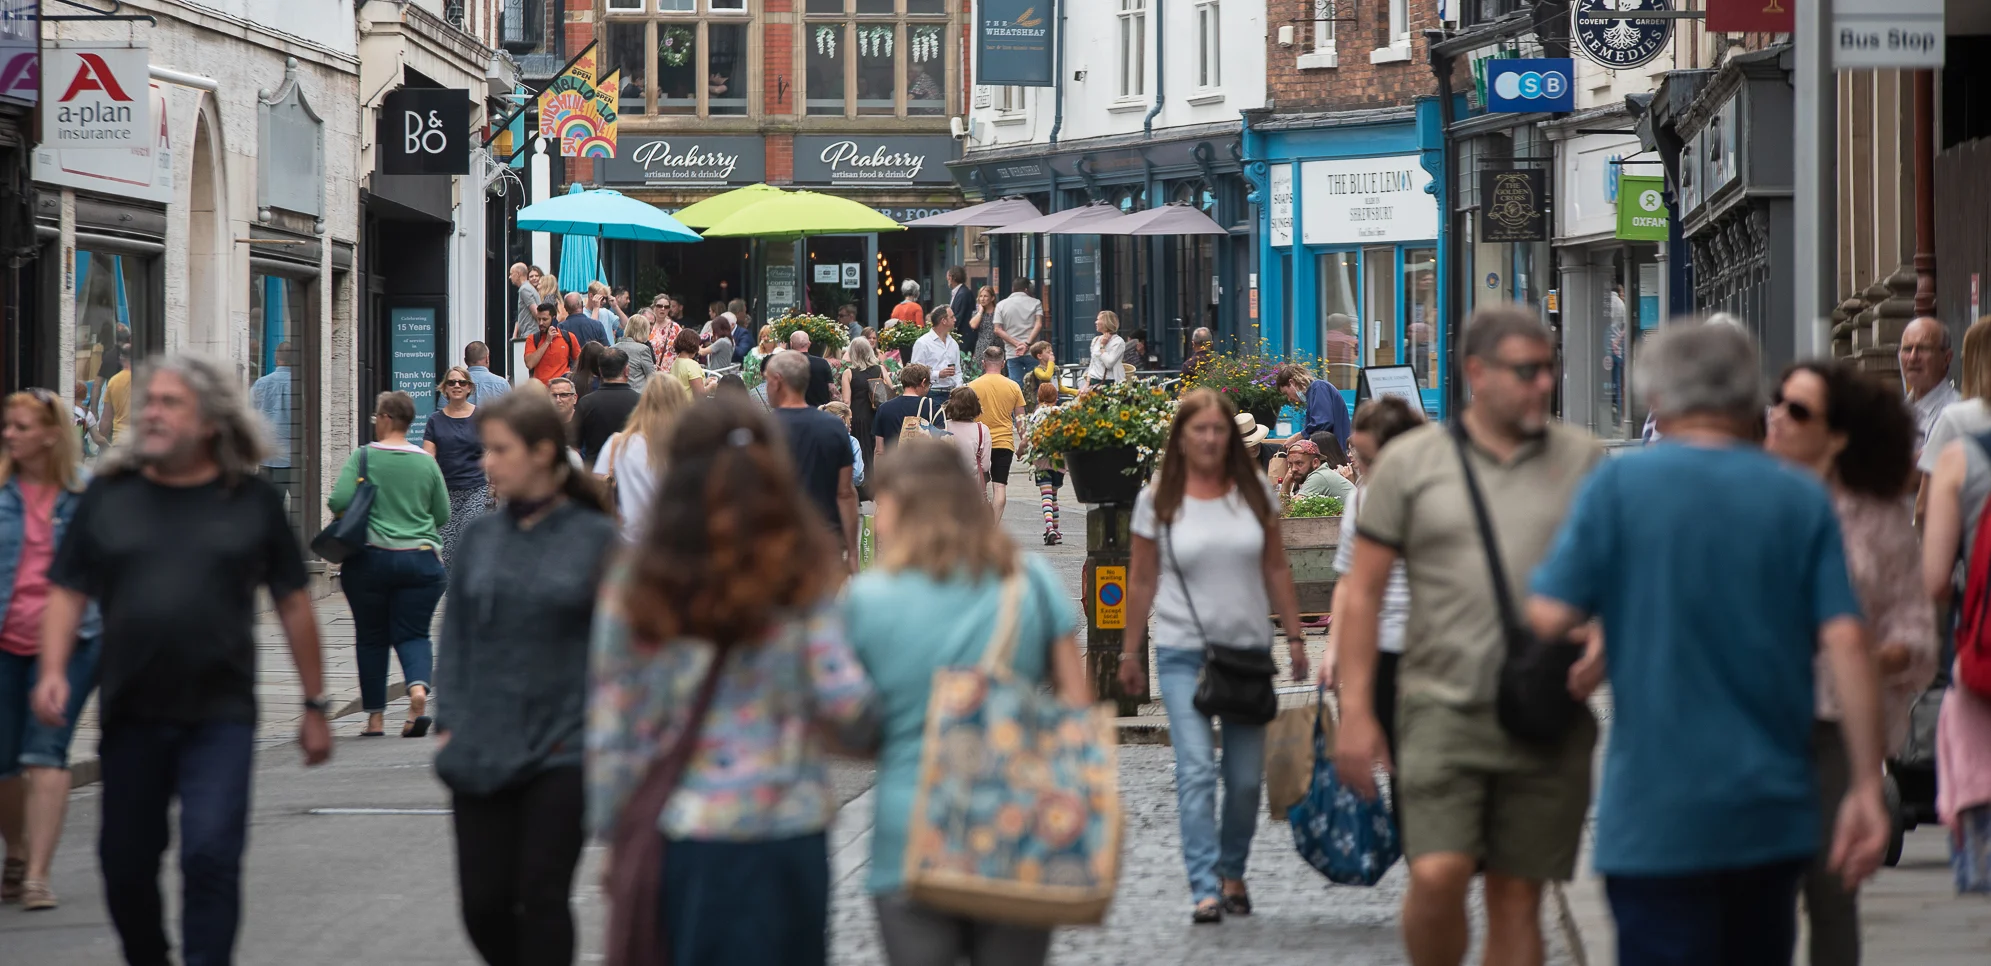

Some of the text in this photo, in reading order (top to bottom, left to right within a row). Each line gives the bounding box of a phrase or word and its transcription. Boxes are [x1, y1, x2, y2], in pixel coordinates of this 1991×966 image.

[985, 28, 1046, 37] WHEATSHEAF
[1581, 29, 1663, 62] REMEDIES
[1839, 28, 1935, 54] Bus Stop
[571, 67, 592, 81] OPEN
[57, 100, 132, 127] a-plan
[540, 93, 588, 136] SUNSHINE
[58, 127, 132, 140] insurance
[632, 140, 739, 179] Peaberry
[819, 140, 926, 179] Peaberry
[644, 170, 671, 178] artisan
[672, 170, 689, 178] food
[690, 170, 697, 178] &
[831, 170, 858, 178] artisan
[859, 170, 877, 178] food
[878, 170, 884, 178] &
[1328, 173, 1347, 195] THE
[1350, 171, 1378, 195] BLUE
[1349, 206, 1394, 221] SHREWSBURY
[1632, 216, 1667, 228] OXFAM
[397, 323, 431, 331] 15 Years
[394, 351, 435, 359] Shrewsbury
[394, 371, 436, 379] Thank You
[412, 381, 432, 389] your
